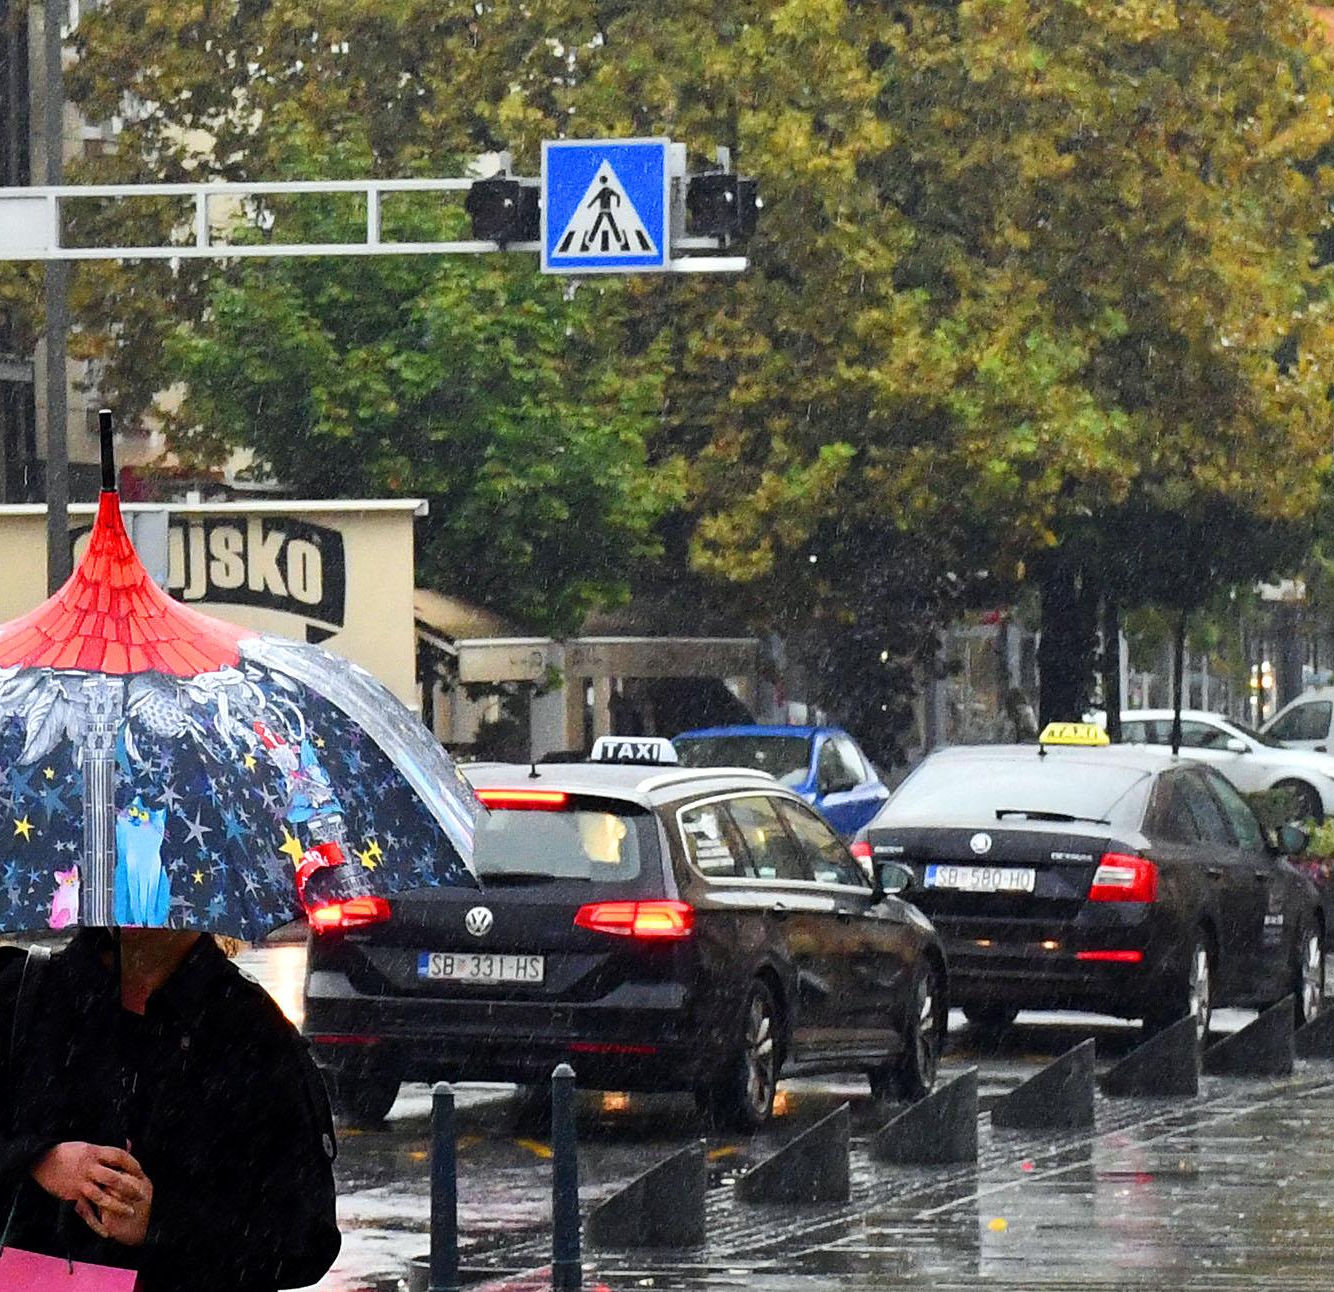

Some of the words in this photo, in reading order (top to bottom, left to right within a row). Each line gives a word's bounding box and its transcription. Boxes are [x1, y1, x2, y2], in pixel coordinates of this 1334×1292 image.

[604, 742, 659, 760] TAXI
[938, 869, 957, 885] SB
[431, 955, 455, 977] SB
[470, 955, 540, 979] 331-HS
